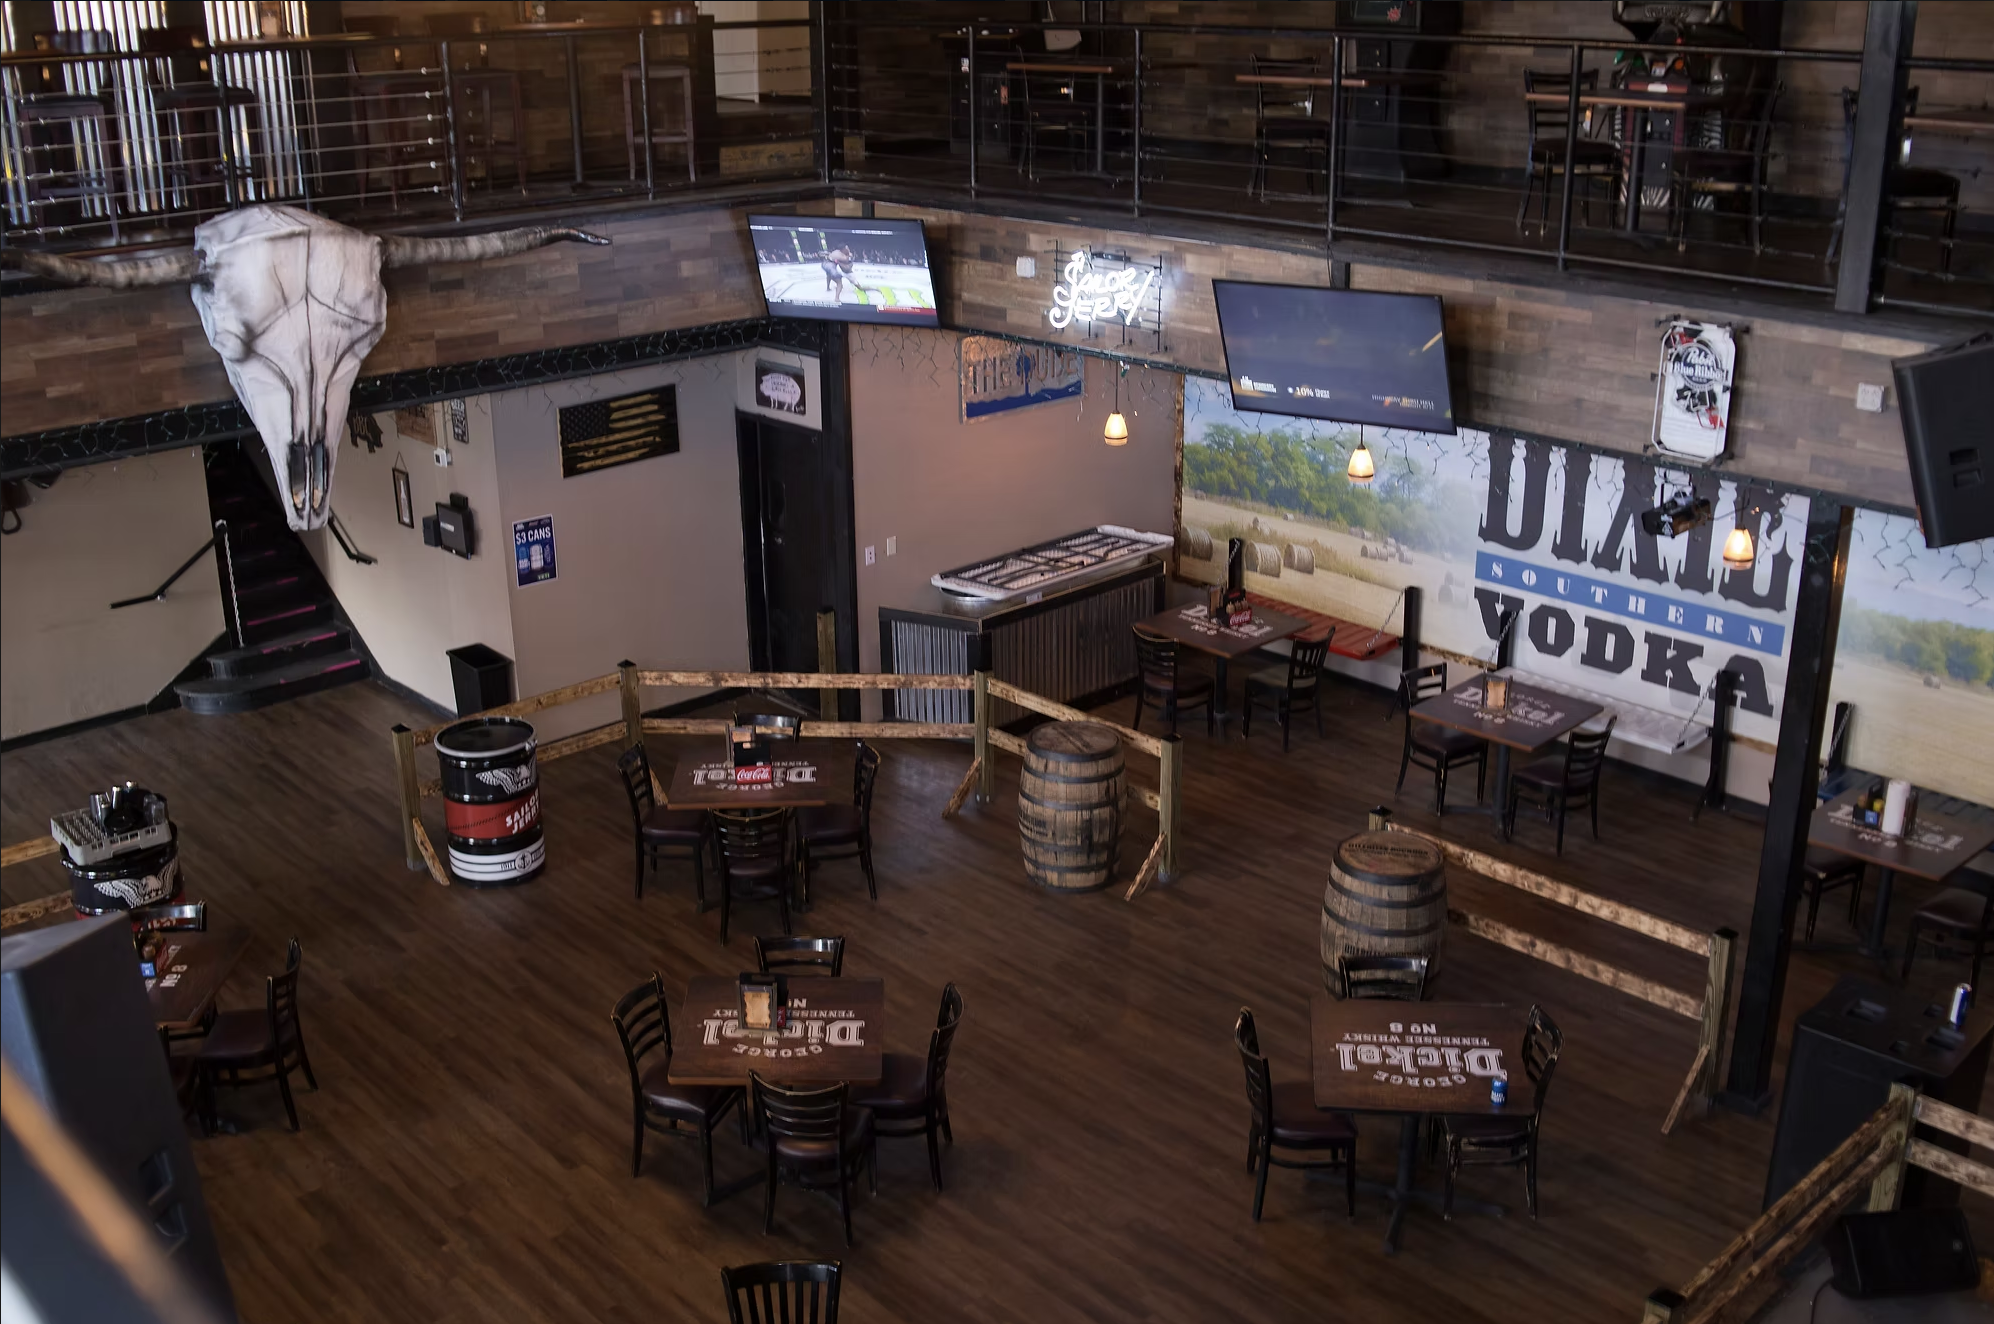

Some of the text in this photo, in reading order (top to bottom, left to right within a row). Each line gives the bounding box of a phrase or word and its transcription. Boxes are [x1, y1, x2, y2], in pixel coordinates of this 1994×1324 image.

[527, 526, 551, 543] CANS
[1491, 560, 1764, 646] SOUTHERN
[1474, 587, 1774, 717] VODKA
[1342, 1032, 1490, 1046] TENNESSEE WHISKY
[732, 1042, 823, 1059] GEORGE
[1335, 1042, 1508, 1078] Dickel
[1372, 1070, 1467, 1088] GEORGE
